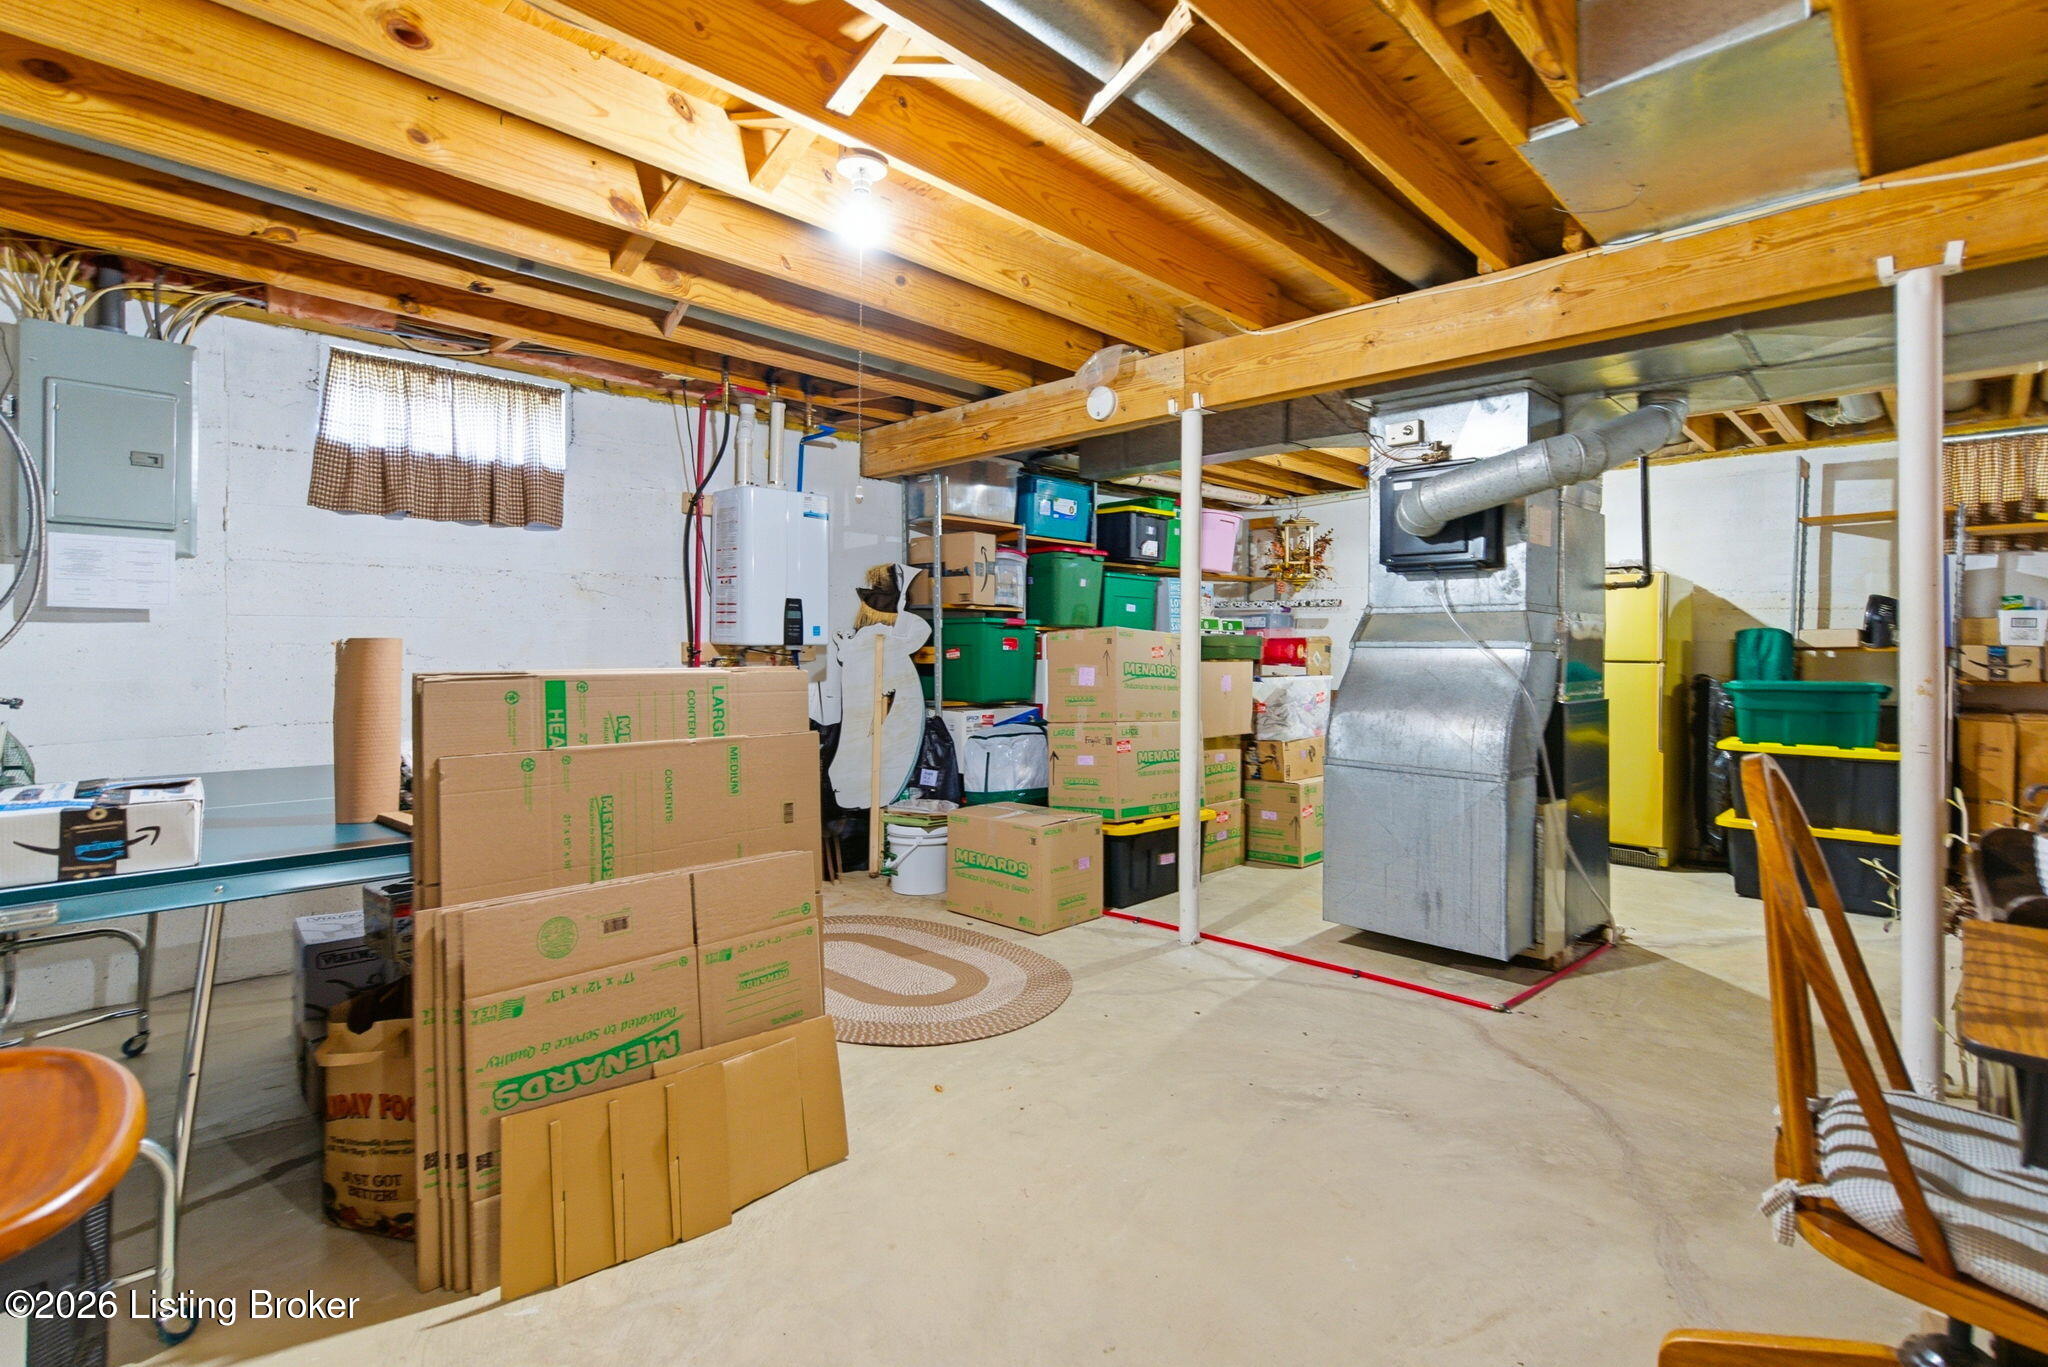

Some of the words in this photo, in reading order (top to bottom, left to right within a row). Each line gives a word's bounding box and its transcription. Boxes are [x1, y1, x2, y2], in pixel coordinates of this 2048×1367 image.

[1123, 661, 1178, 679] MENARDS
[728, 746, 740, 794] MEDIUM
[954, 848, 1030, 879] MENARDS
[493, 1029, 681, 1111] MENARDS
[372, 1173, 402, 1187] GOT
